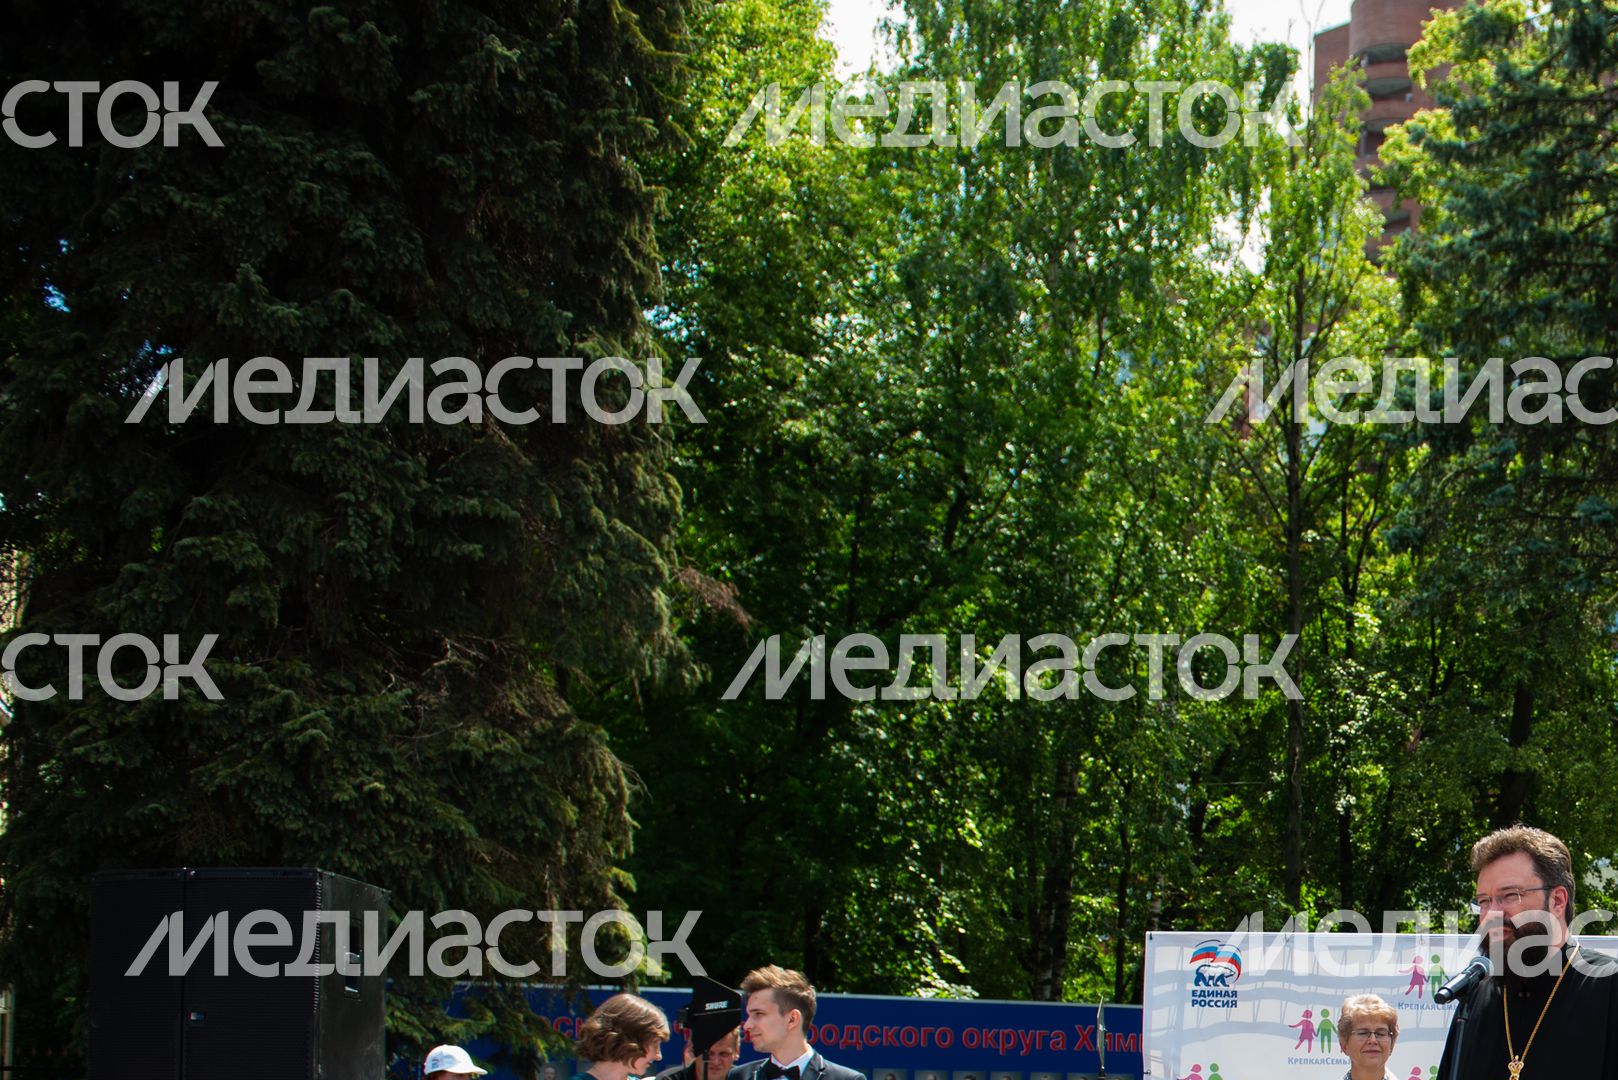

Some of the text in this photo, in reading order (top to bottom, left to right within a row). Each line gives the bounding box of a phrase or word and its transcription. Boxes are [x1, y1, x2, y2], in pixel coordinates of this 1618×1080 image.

[1191, 989, 1238, 999] ЕДИНАЯ
[1191, 999, 1238, 1008] РОССИЯ
[809, 1024, 955, 1051] одского
[962, 1026, 1067, 1057] округа
